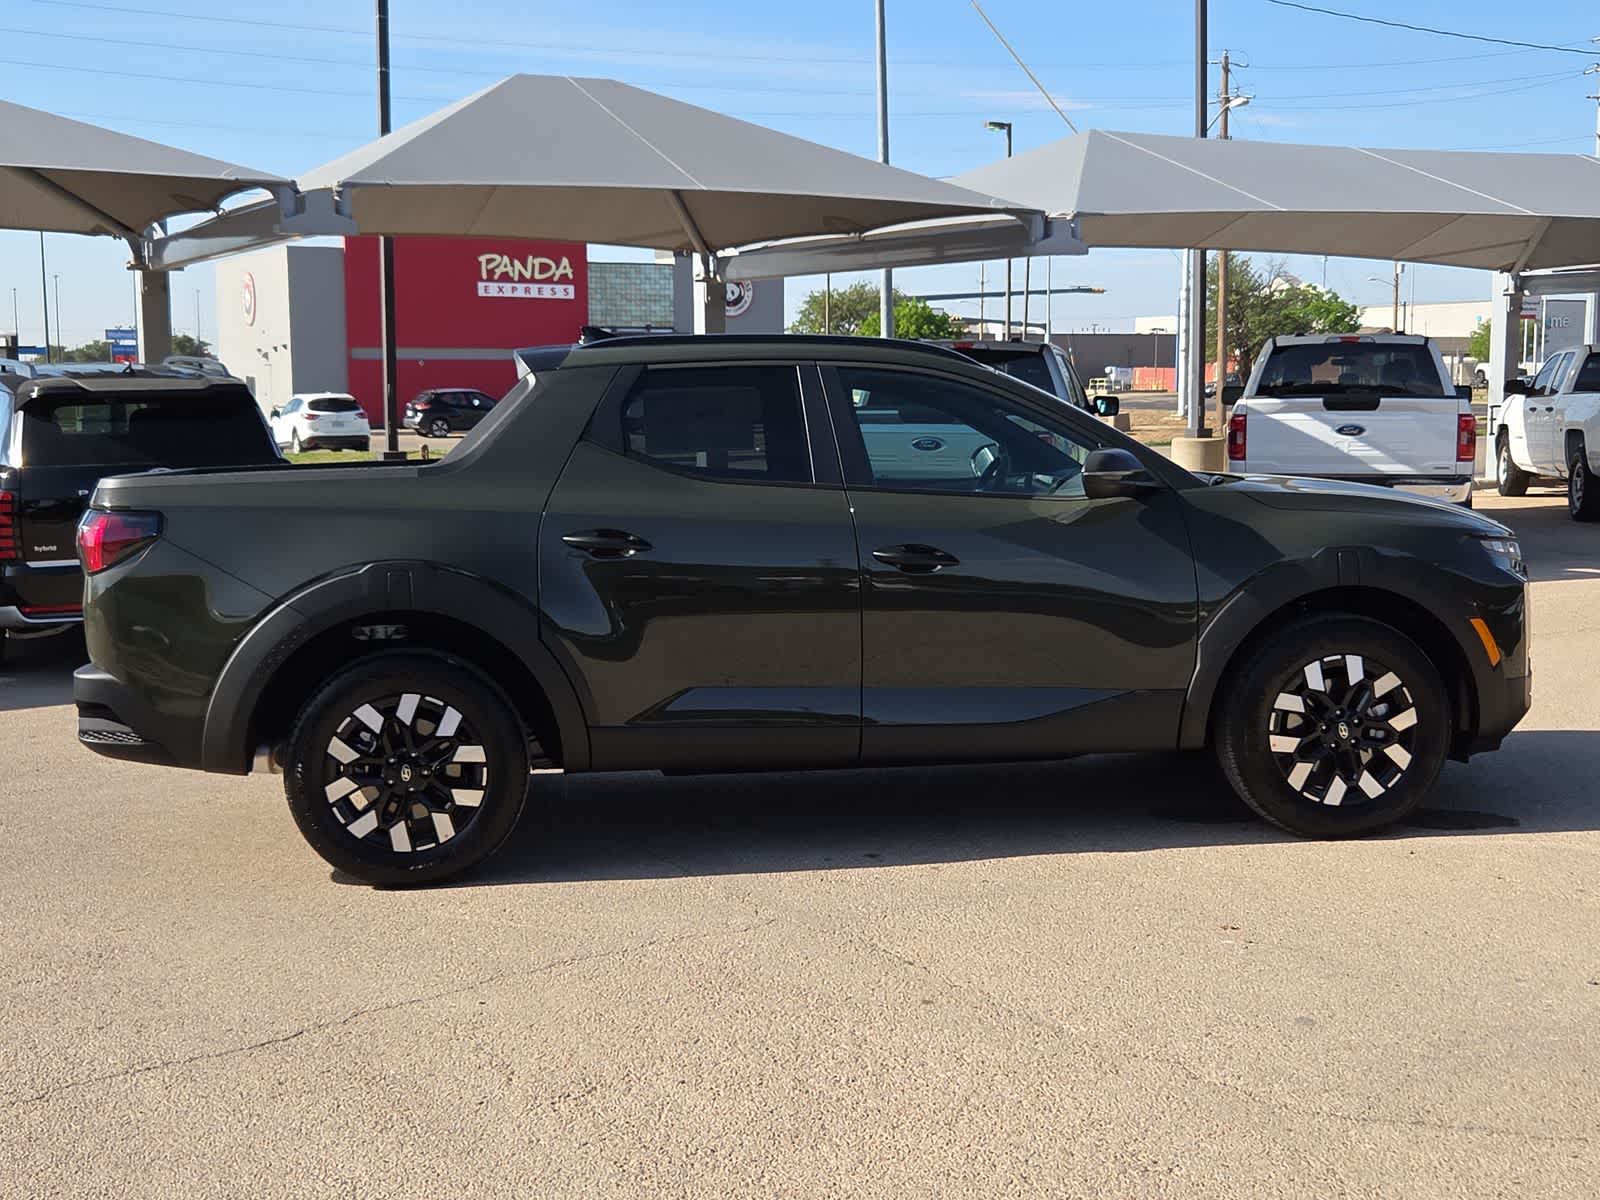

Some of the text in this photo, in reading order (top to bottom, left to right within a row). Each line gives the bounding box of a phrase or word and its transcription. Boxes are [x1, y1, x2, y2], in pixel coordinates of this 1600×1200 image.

[477, 254, 573, 281] PANDA
[483, 285, 570, 296] EXPRESS
[33, 545, 57, 553] hybrid
